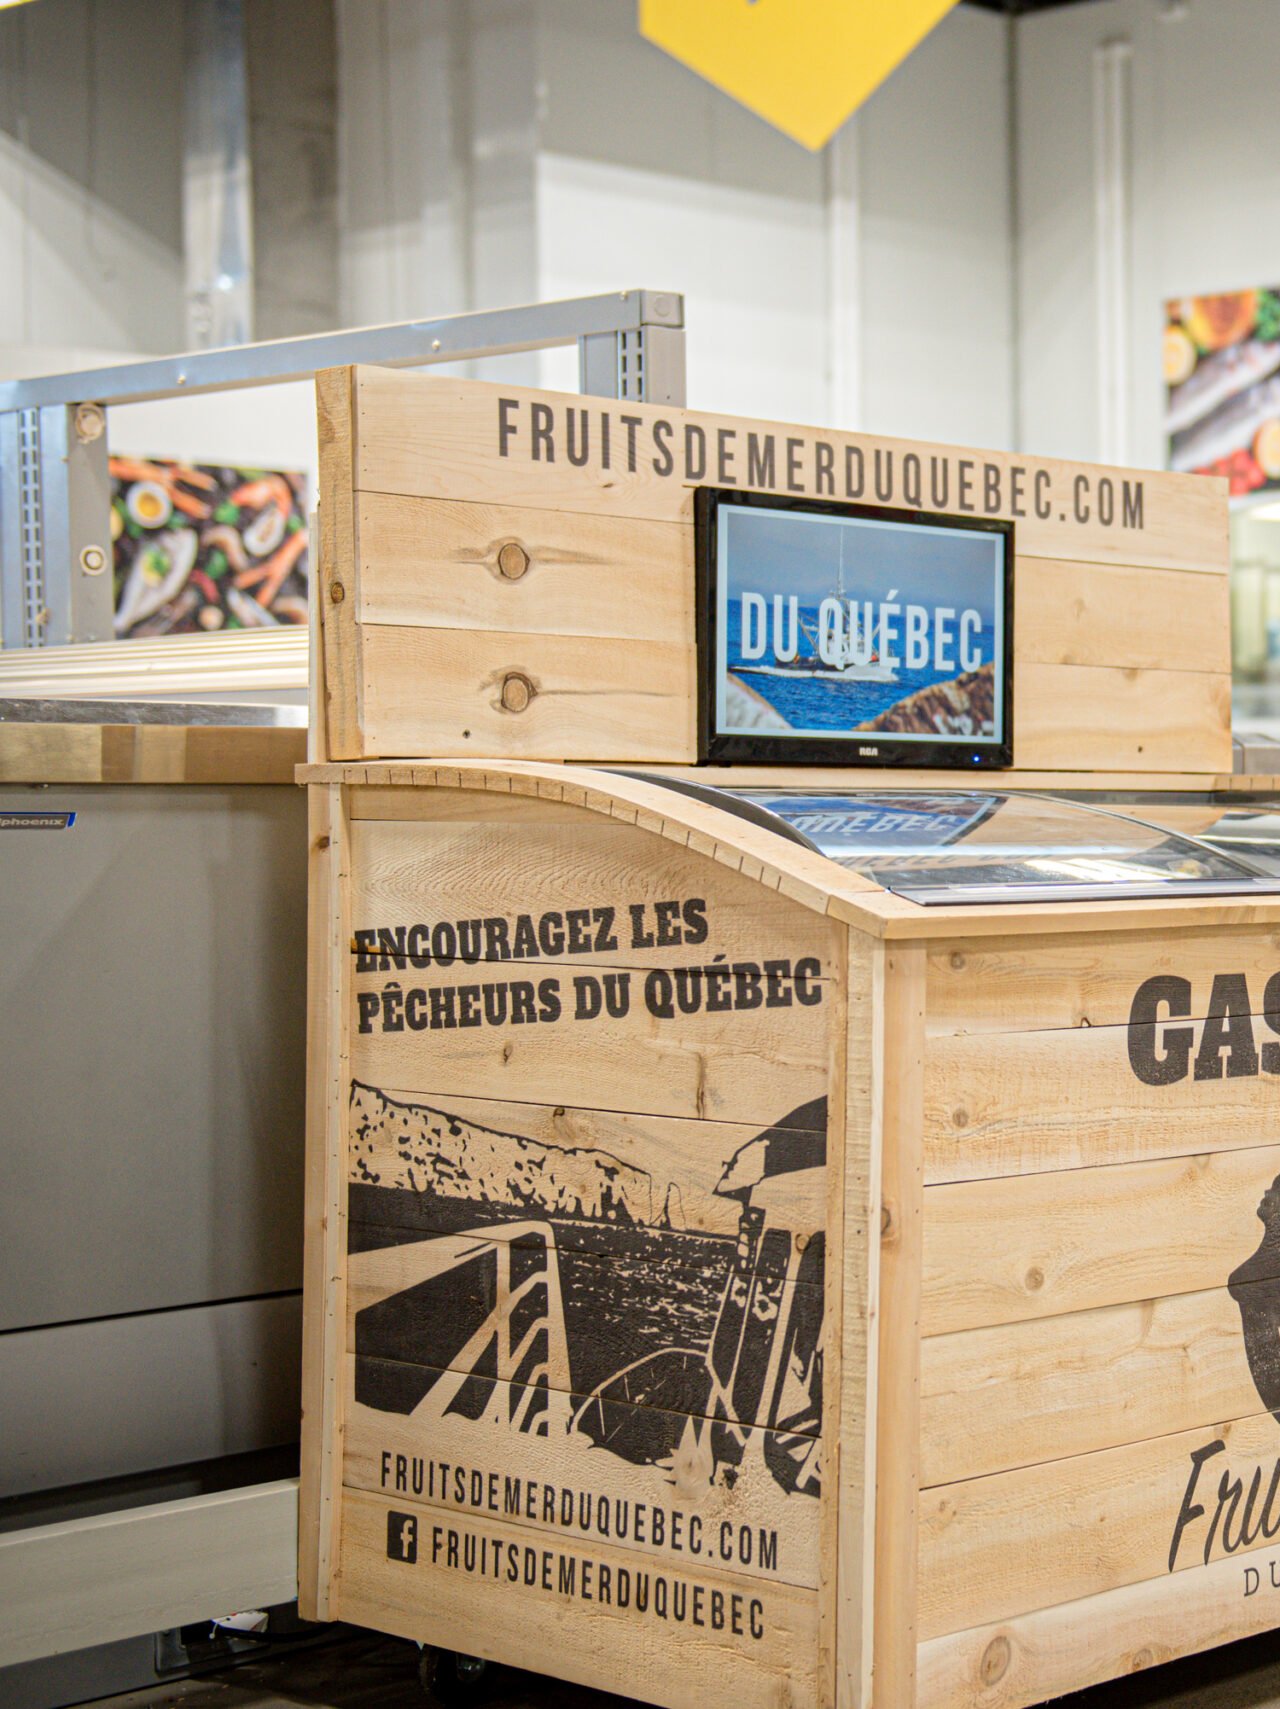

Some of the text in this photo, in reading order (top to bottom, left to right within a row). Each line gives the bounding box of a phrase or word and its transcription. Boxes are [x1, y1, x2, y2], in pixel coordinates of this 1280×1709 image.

[498, 398, 1145, 529] FRUITSDEMERDUQUEBEC.COM
[741, 589, 982, 673] DU QUÉBEC
[859, 746, 879, 757] RCA
[354, 897, 709, 974] ENCOURAGEZ LES
[357, 954, 823, 1035] PÊCHEURS DU QUÉBEC
[381, 1450, 778, 1571] FRUITSDEMERDUQUEBEC.COM
[432, 1526, 764, 1640] FRUITSDEMERDUQUEBEC
